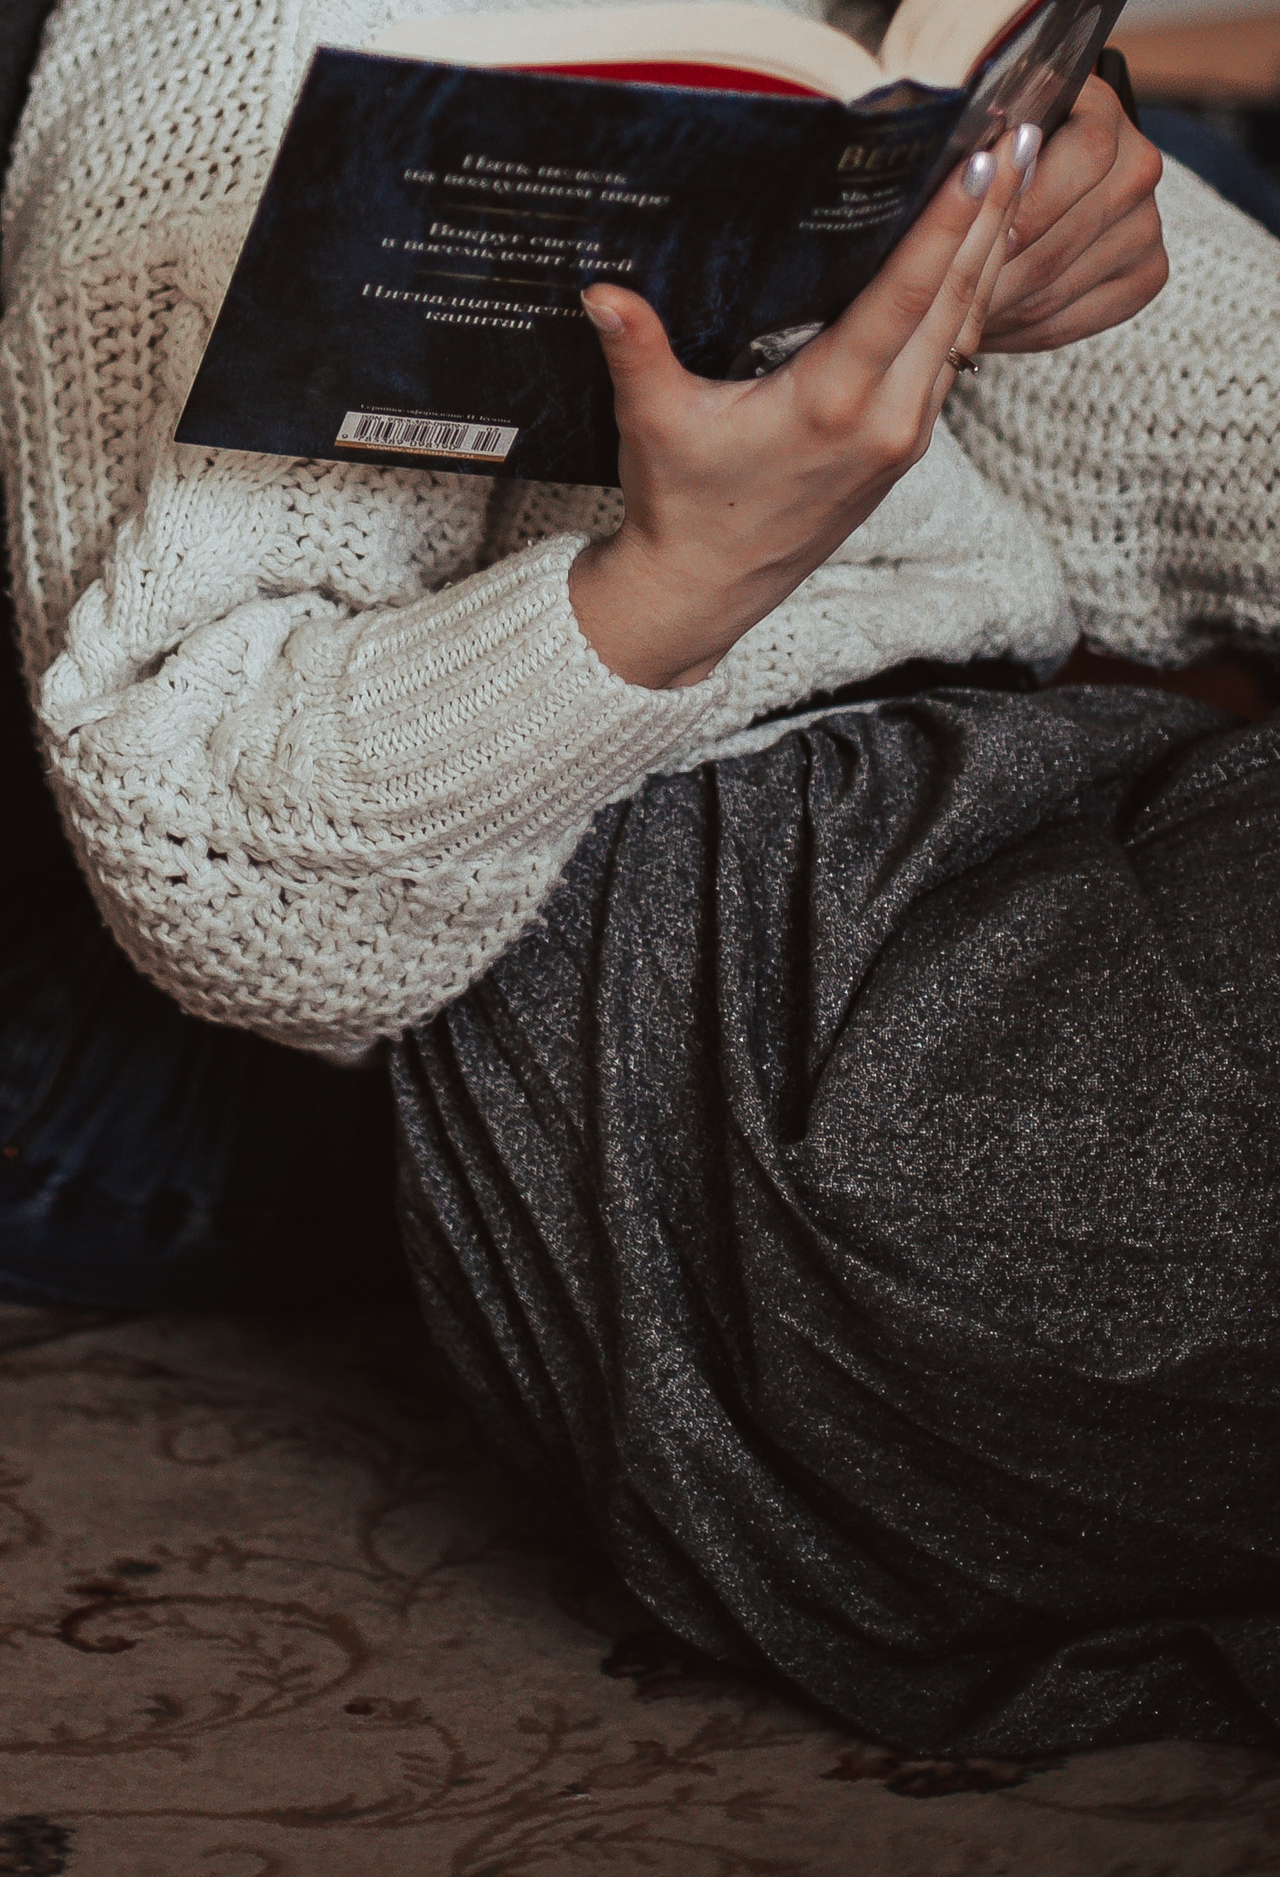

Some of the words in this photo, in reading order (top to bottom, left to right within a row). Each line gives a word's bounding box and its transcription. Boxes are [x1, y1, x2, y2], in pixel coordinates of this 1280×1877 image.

[462, 152, 531, 177] Пять
[537, 165, 628, 187] недель
[403, 167, 436, 184] на
[443, 173, 593, 200] воздушном
[600, 189, 672, 208] шаре
[428, 221, 524, 247] Вокруг
[529, 233, 602, 253] света
[380, 236, 396, 249] в
[404, 239, 567, 266] восемьдесят
[572, 255, 635, 273] дней
[425, 310, 535, 331] капитан
[361, 414, 382, 423] ISBN
